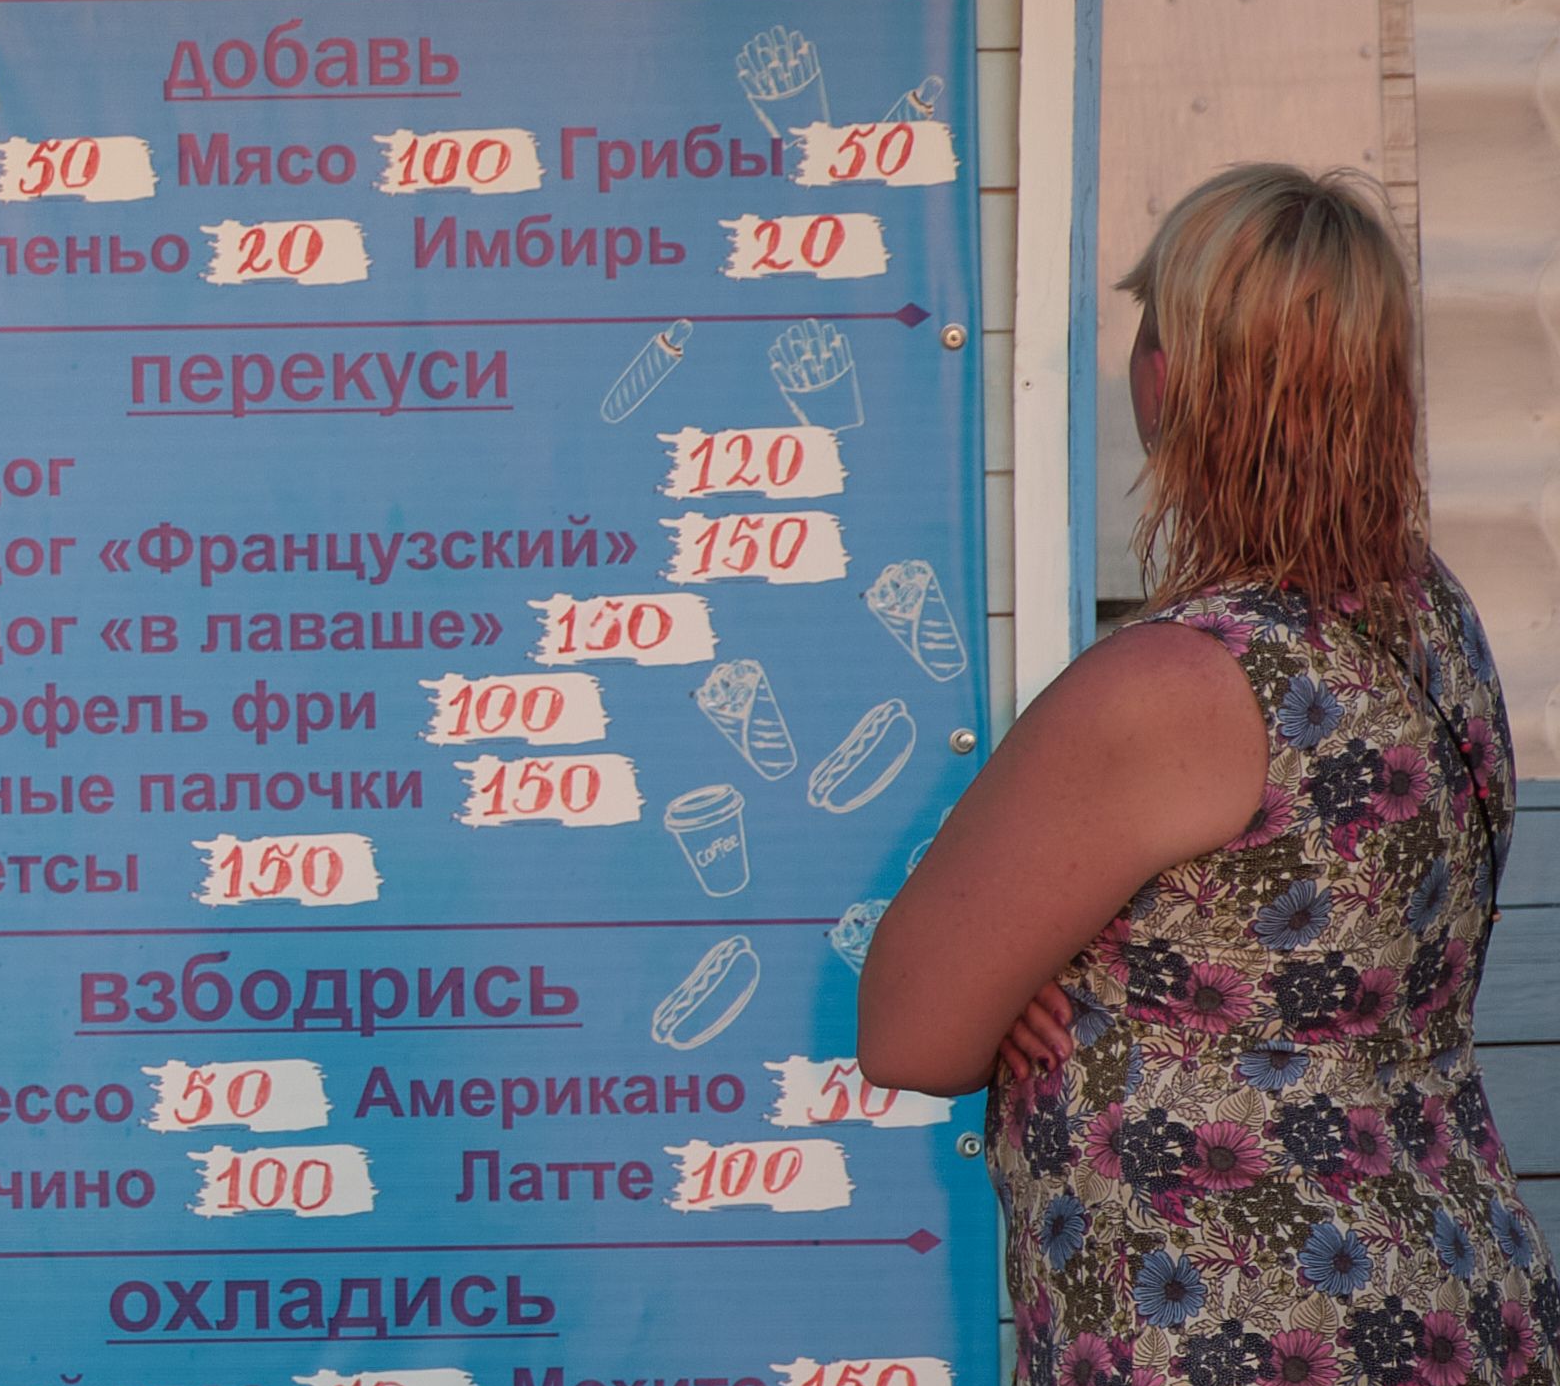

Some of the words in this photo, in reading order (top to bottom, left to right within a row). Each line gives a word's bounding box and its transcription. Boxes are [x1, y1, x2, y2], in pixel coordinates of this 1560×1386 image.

[165, 19, 460, 98] добавь
[14, 137, 102, 194] 50
[178, 130, 357, 189] Мясо
[395, 136, 515, 191] 100
[559, 124, 784, 195] Грибы
[829, 123, 916, 179] 50
[236, 223, 324, 278] 20
[412, 215, 687, 281] Имбирь
[750, 214, 845, 270] 20
[128, 340, 512, 413] перекуси
[687, 434, 806, 491] 120
[97, 515, 640, 586] «Французский»
[692, 517, 809, 574] 150
[97, 605, 184, 655] «в
[199, 605, 504, 655] лаваше»
[554, 600, 674, 655] 150
[232, 680, 379, 746] фри
[445, 683, 567, 738] 100
[138, 765, 425, 816] палочки
[482, 763, 602, 818] 150
[217, 844, 342, 901] 150
[77, 950, 581, 1033] взбодрись
[172, 1068, 273, 1125] 50
[354, 1064, 747, 1132] Американо
[213, 1156, 333, 1212] 100
[456, 1147, 655, 1203] Латте
[687, 1145, 803, 1202] 100
[107, 1267, 557, 1342] охладись
